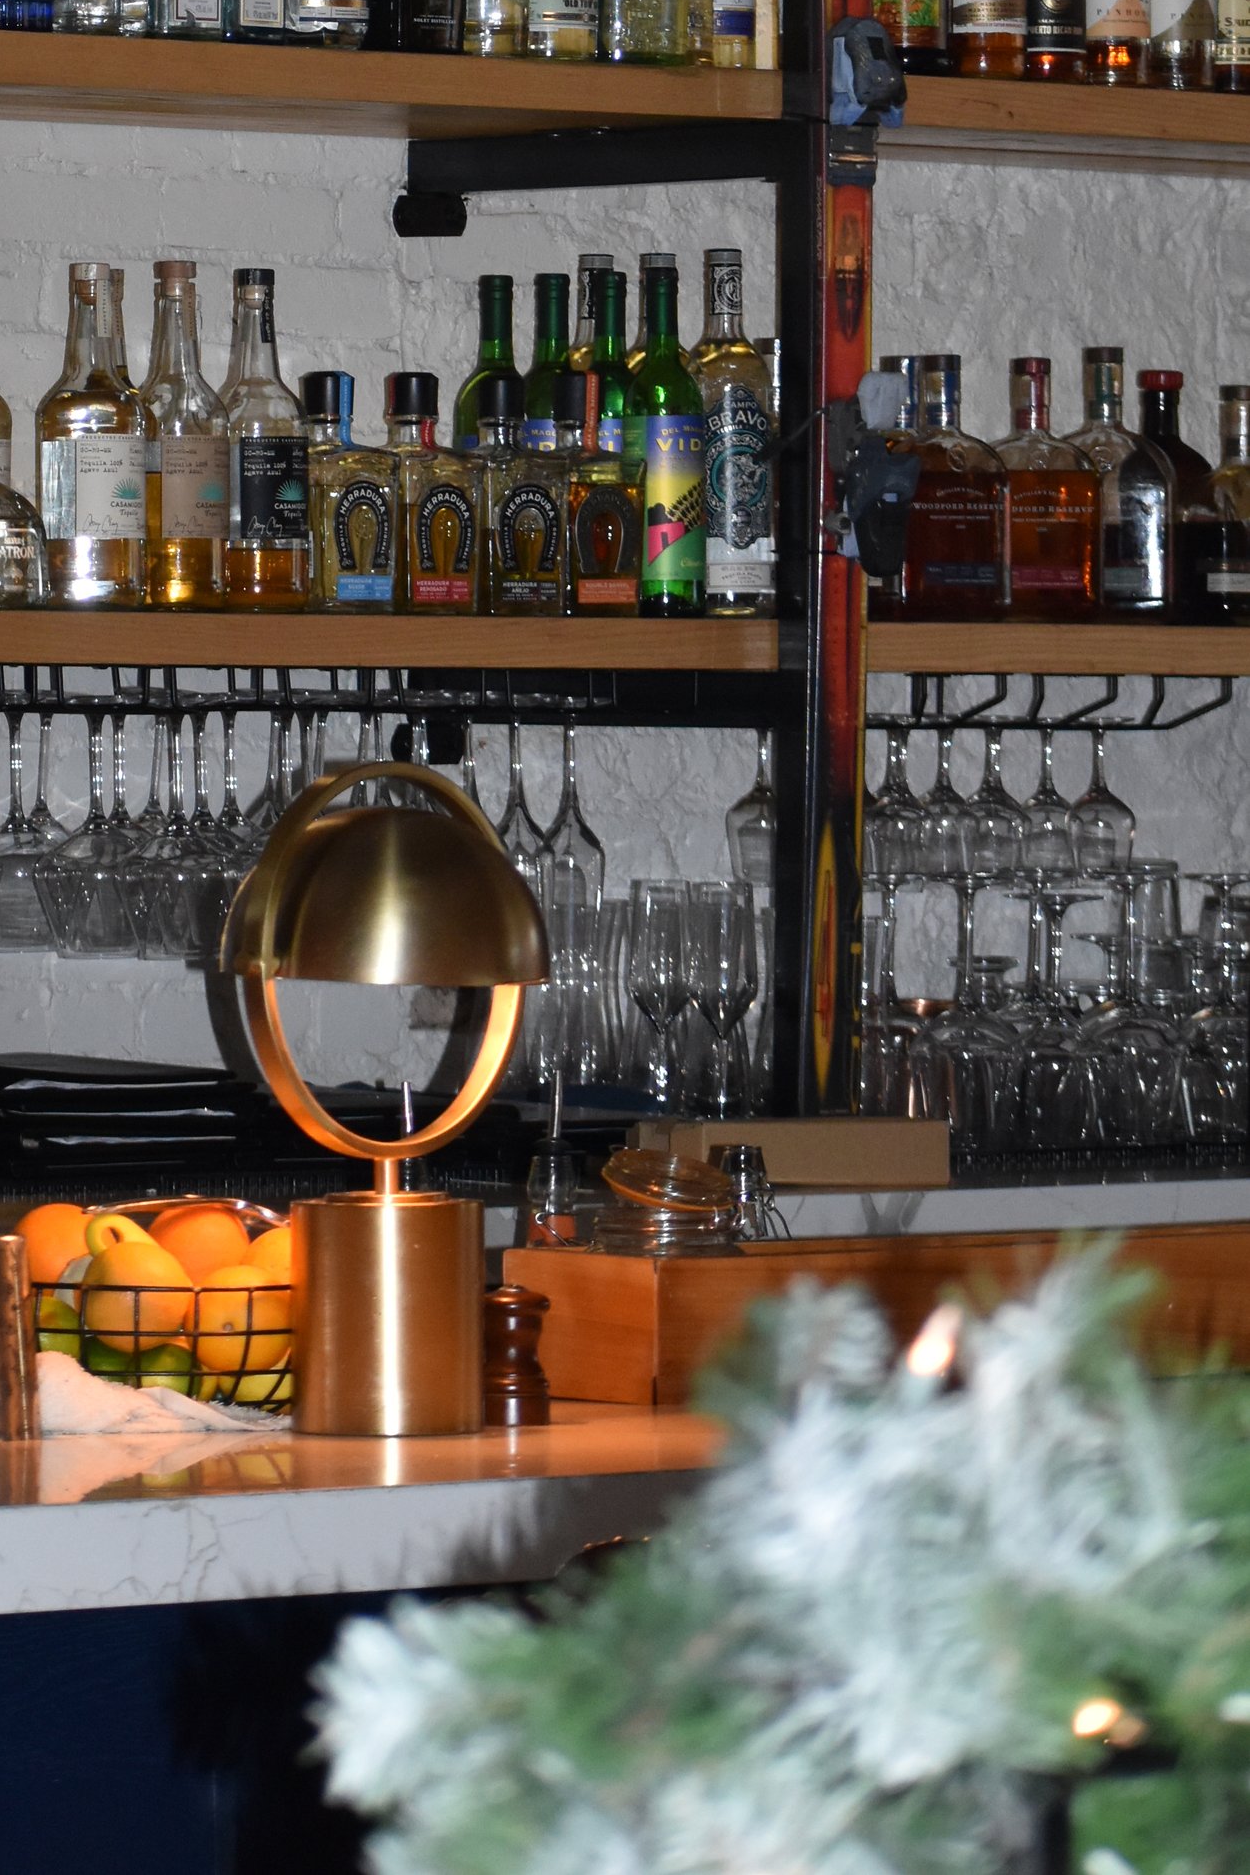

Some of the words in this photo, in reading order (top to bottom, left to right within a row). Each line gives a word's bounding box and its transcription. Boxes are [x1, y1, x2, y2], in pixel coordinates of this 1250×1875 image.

[723, 401, 757, 411] CAMPO
[708, 411, 767, 431] BRAVO
[661, 428, 679, 437] DEL
[80, 467, 100, 475] Agave
[244, 469, 264, 477] Agave
[340, 489, 386, 515] HERRADURA
[422, 493, 470, 519] HERRADURA
[504, 492, 555, 517] HERRADURA
[912, 503, 964, 511] WOODFORD
